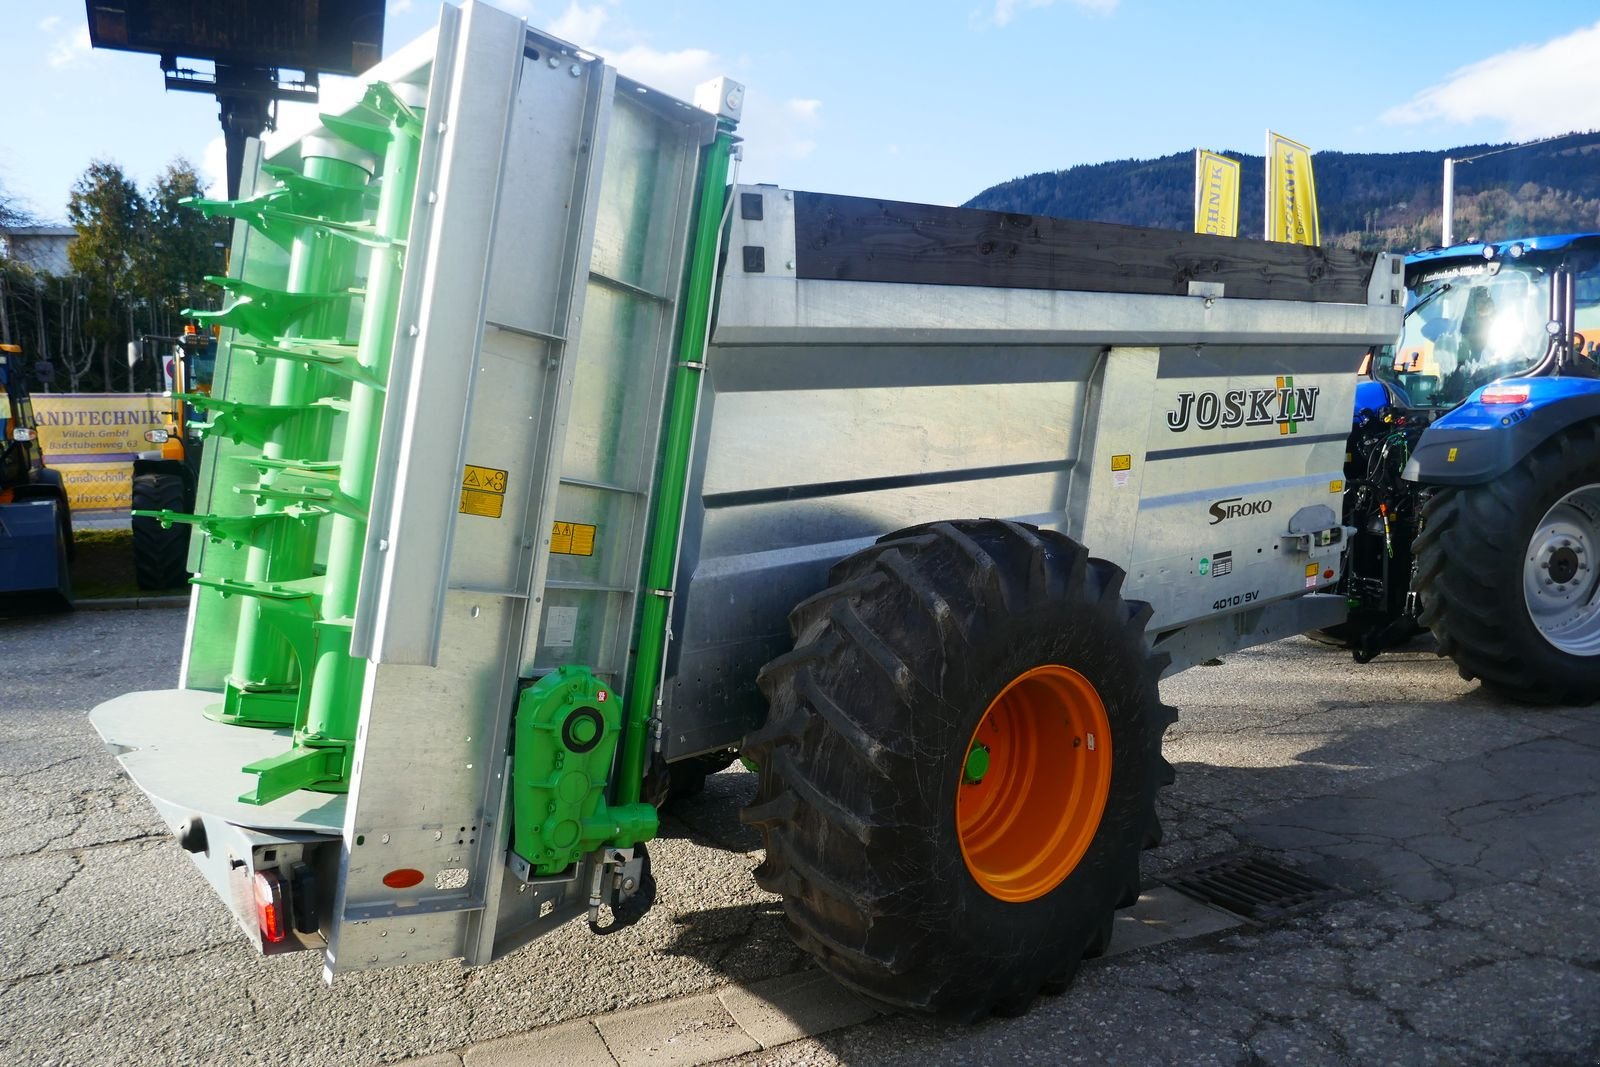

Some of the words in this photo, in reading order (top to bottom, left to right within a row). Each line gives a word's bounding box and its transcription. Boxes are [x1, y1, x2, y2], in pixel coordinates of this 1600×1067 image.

[1206, 165, 1222, 235] CHNIK
[1285, 152, 1295, 241] ECHNIK
[35, 410, 162, 426] ANDTECHNIK
[1167, 386, 1319, 432] JOSKIN
[62, 430, 96, 439] Villach
[98, 429, 129, 438] GmbH
[126, 440, 138, 448] 63
[1209, 497, 1272, 525] SIROKO
[1212, 590, 1259, 610] 4010/9V
